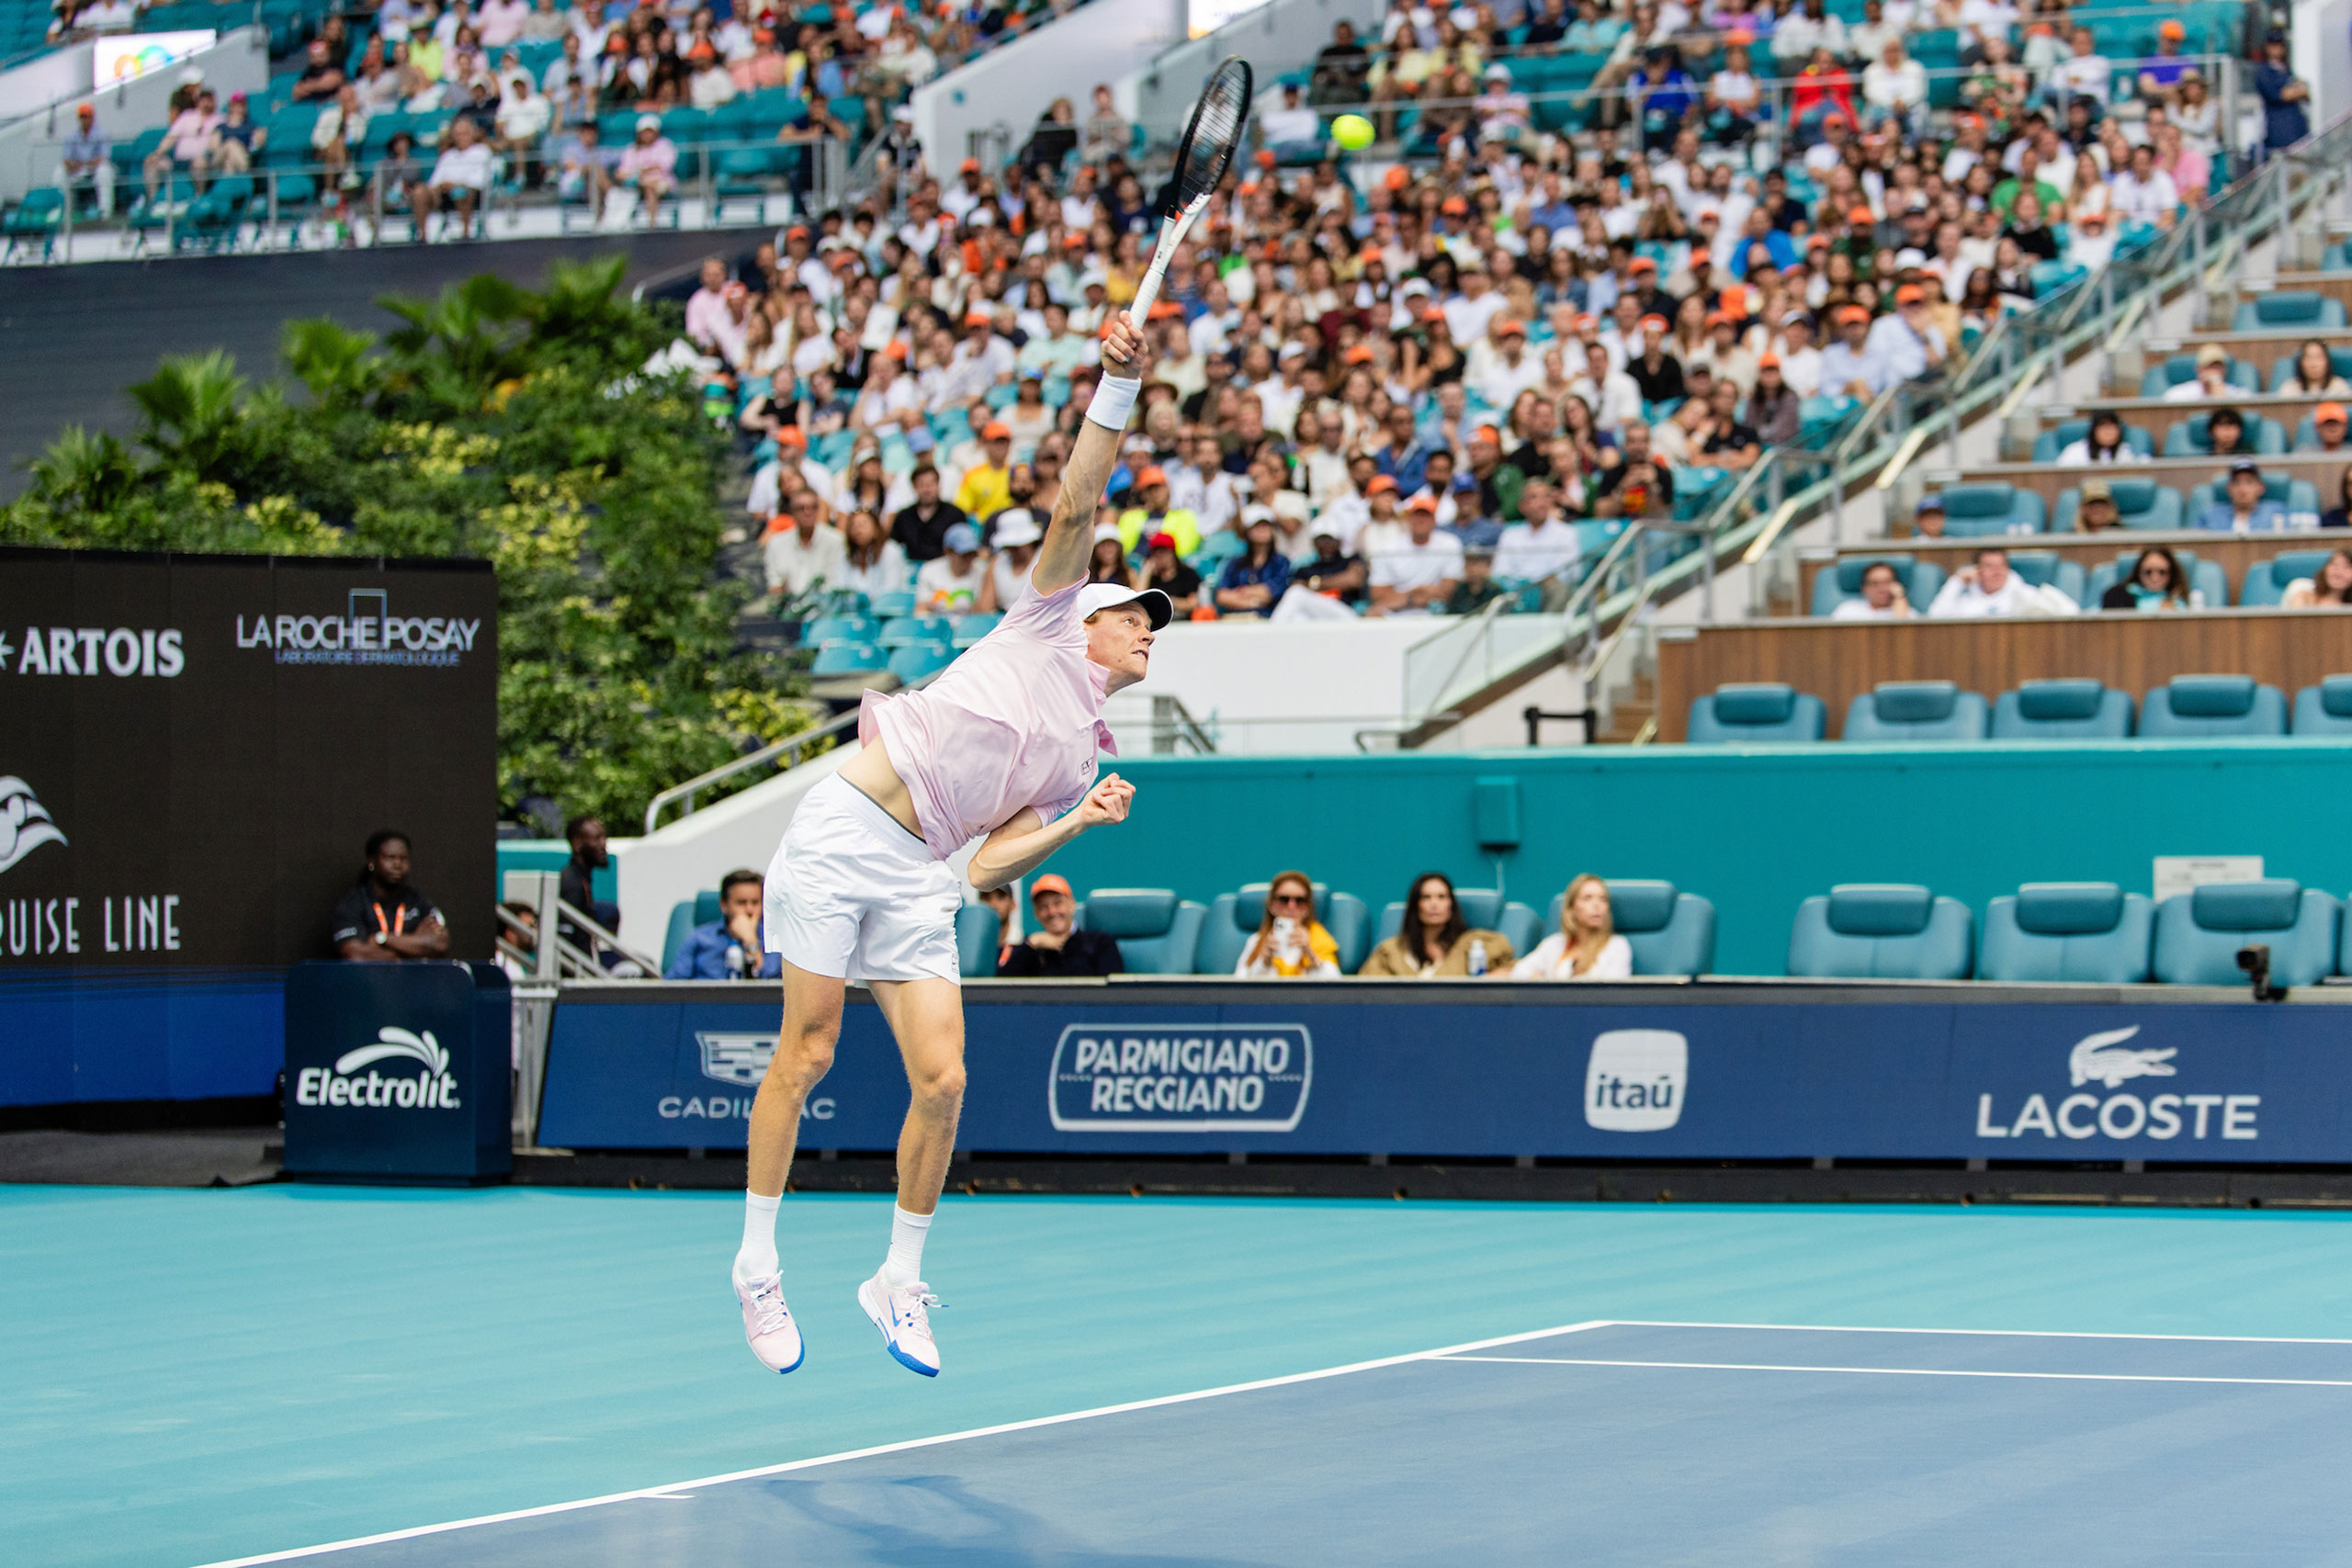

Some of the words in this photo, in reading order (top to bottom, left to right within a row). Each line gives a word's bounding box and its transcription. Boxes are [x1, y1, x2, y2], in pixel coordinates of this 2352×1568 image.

[18, 626, 185, 678] ARTOIS
[236, 614, 273, 649] LA
[275, 615, 379, 650] ROCHE
[384, 616, 481, 652] POSAY
[0, 897, 81, 957] UISE
[104, 894, 181, 953] LINE
[1074, 1037, 1291, 1075] PARMIGIANO
[295, 1066, 458, 1110] Electrolit
[1091, 1076, 1265, 1113] REGGIANO
[1595, 1073, 1674, 1110] itaú
[657, 1096, 837, 1121] CADILC
[1975, 1093, 2261, 1140] LACOSTE
